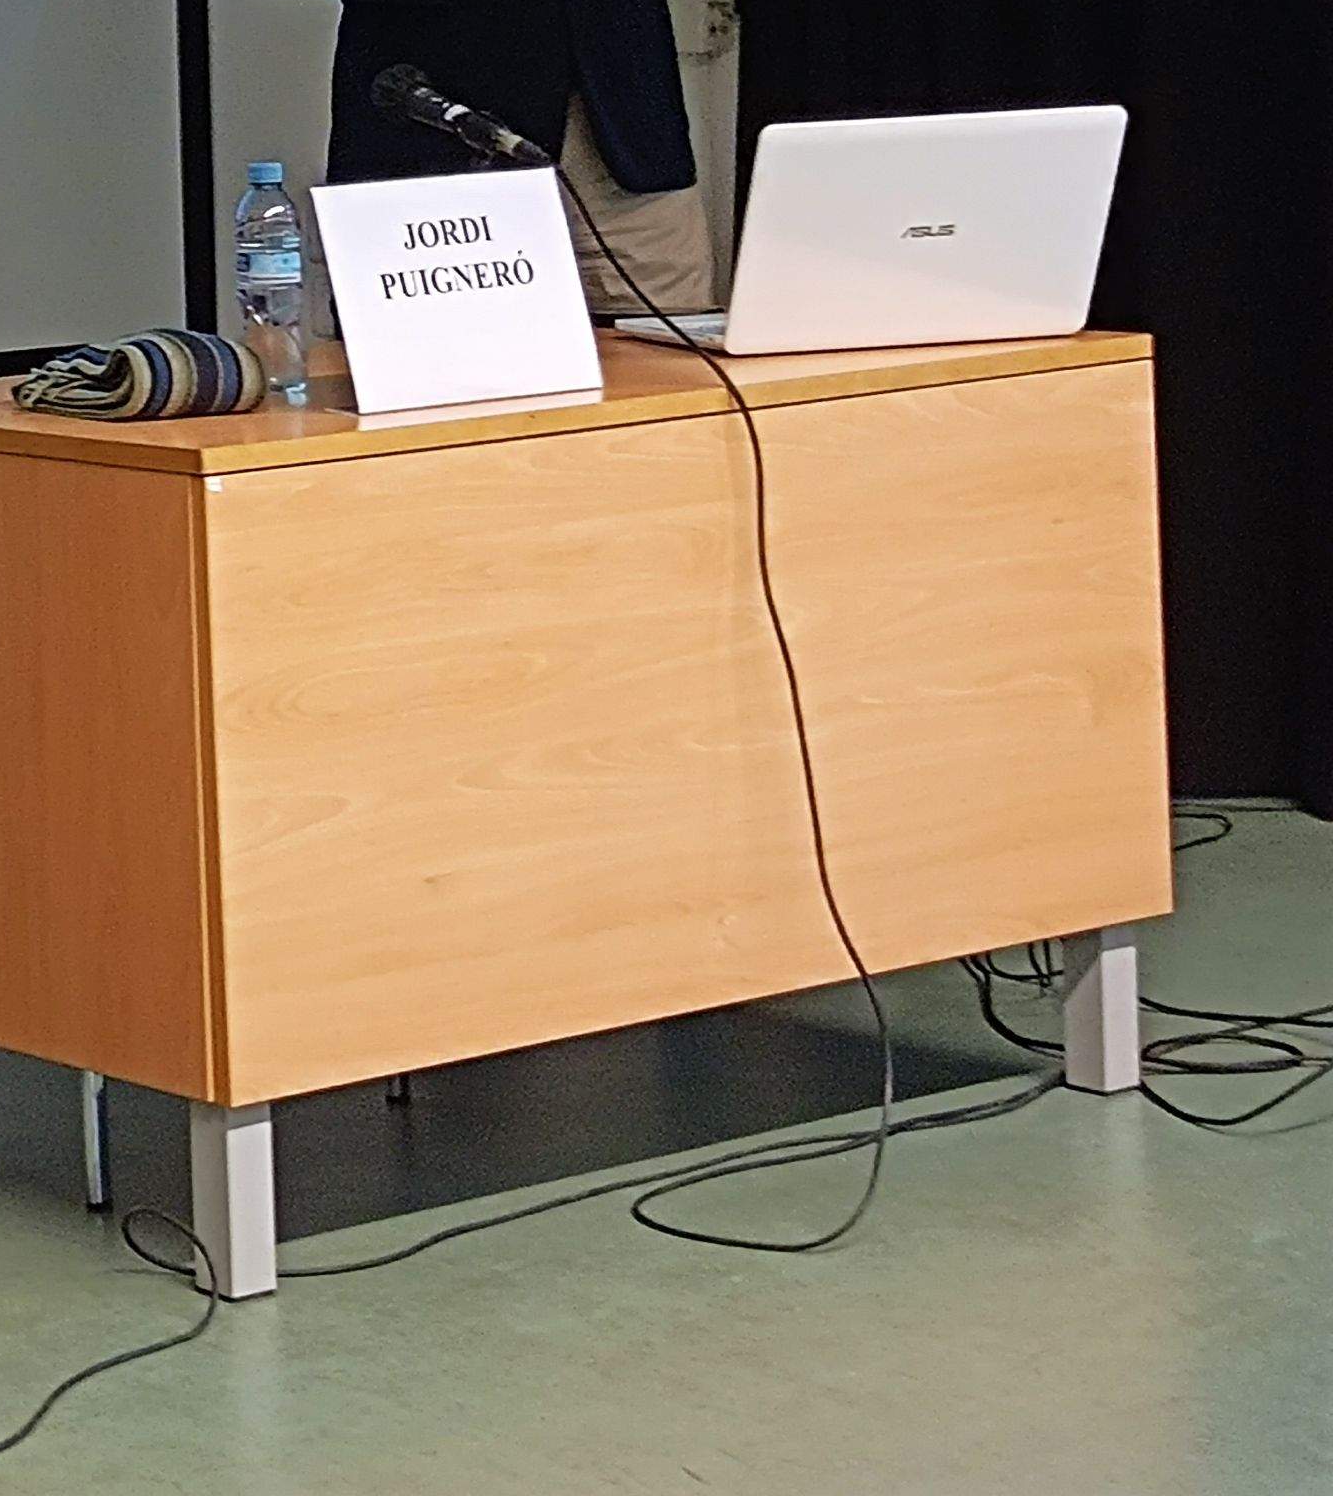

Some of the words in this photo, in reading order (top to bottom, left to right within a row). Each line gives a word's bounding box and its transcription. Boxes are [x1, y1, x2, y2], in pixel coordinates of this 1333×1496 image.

[404, 215, 493, 250] JORDI
[900, 224, 956, 239] ASUS
[379, 249, 534, 300] PUIGNERÓ
